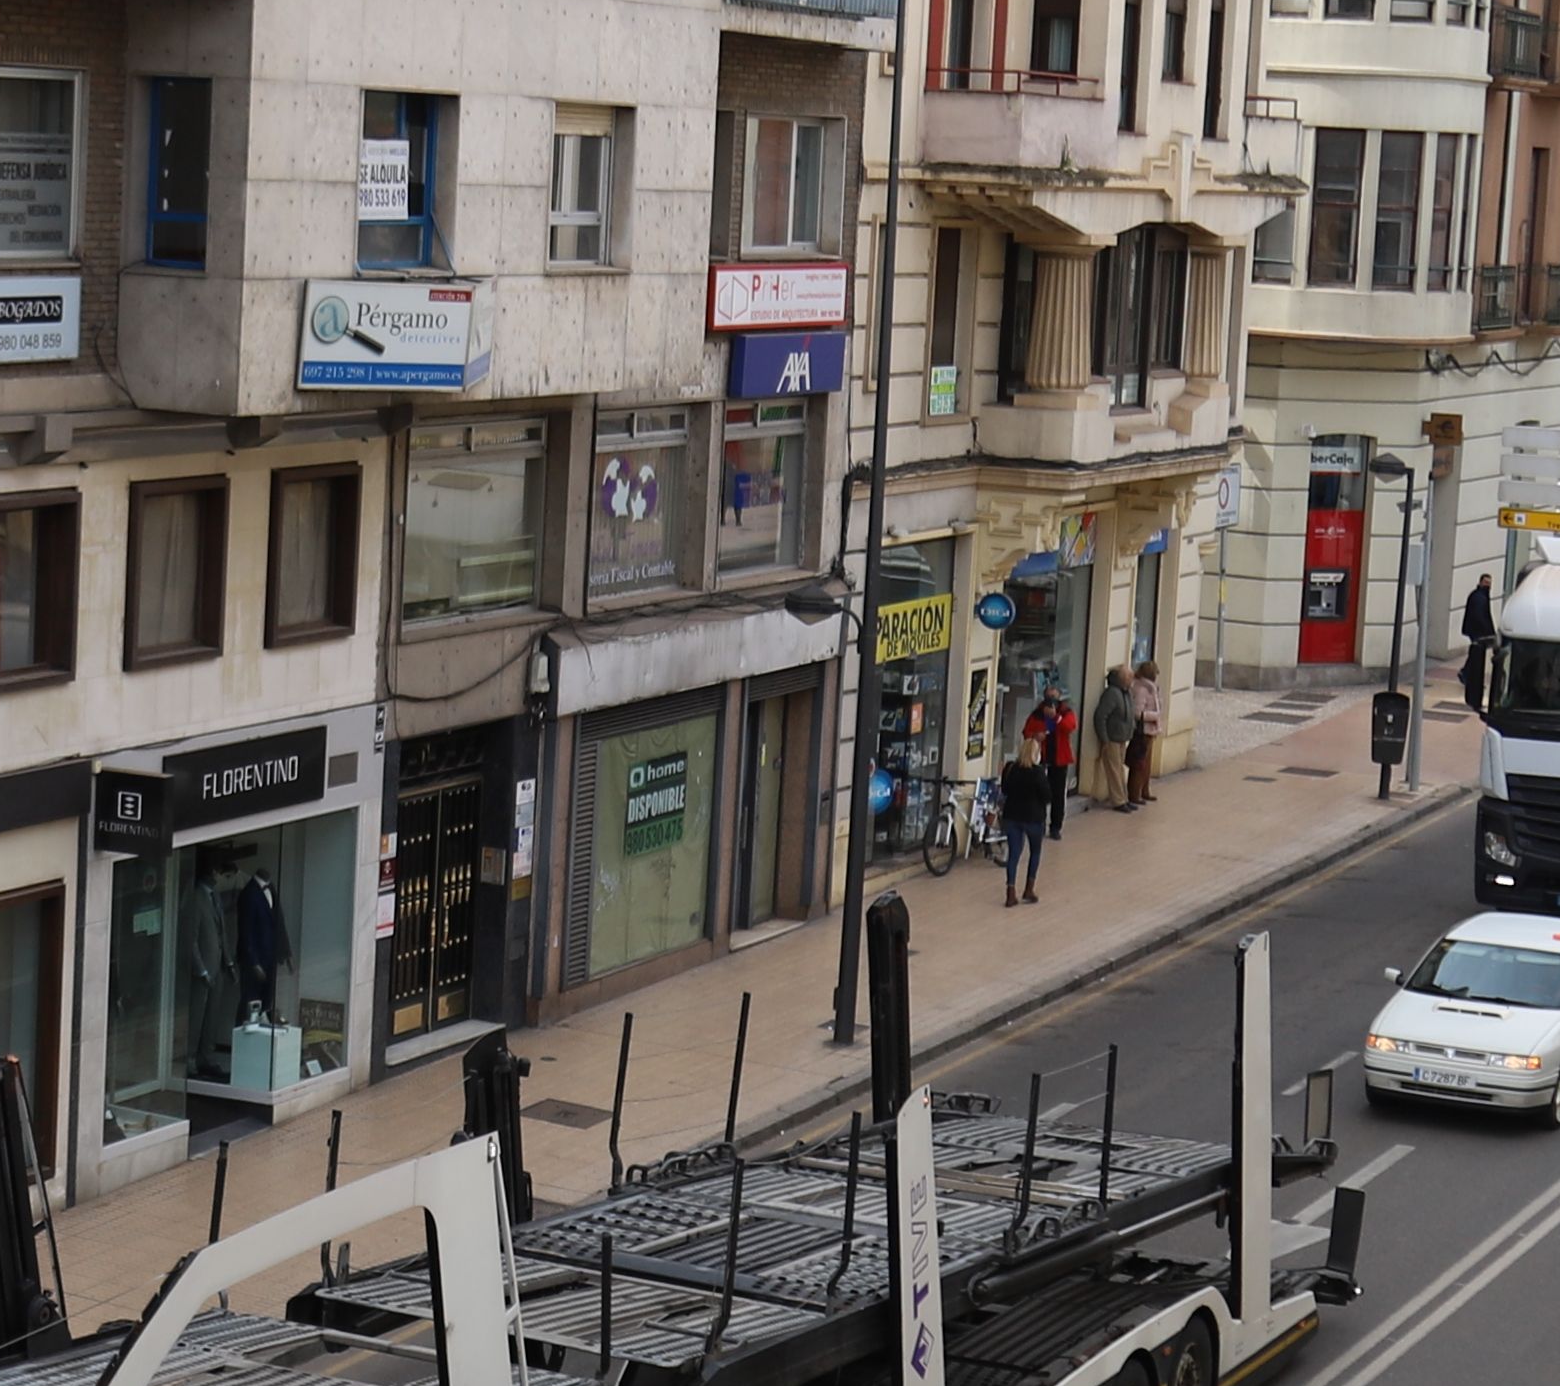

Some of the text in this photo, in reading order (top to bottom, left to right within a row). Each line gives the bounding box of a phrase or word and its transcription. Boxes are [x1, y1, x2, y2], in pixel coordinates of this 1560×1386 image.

[359, 164, 406, 184] SE ALQUILA
[359, 189, 406, 207] 980 533 619
[356, 301, 448, 337] Pérgamo
[20, 334, 39, 349] 048
[42, 333, 62, 348] 859
[400, 333, 461, 345] detectives
[304, 367, 323, 380] 697
[376, 367, 462, 387] www.apergamo.es
[776, 352, 811, 393] AXA
[611, 561, 633, 585] Fiscal
[642, 561, 675, 581] Contable
[886, 641, 898, 657] DE
[203, 755, 299, 800] FLORENTINO
[647, 759, 685, 781] home
[628, 785, 686, 823] DISPONIBLE
[98, 820, 158, 839] FLORENTINO
